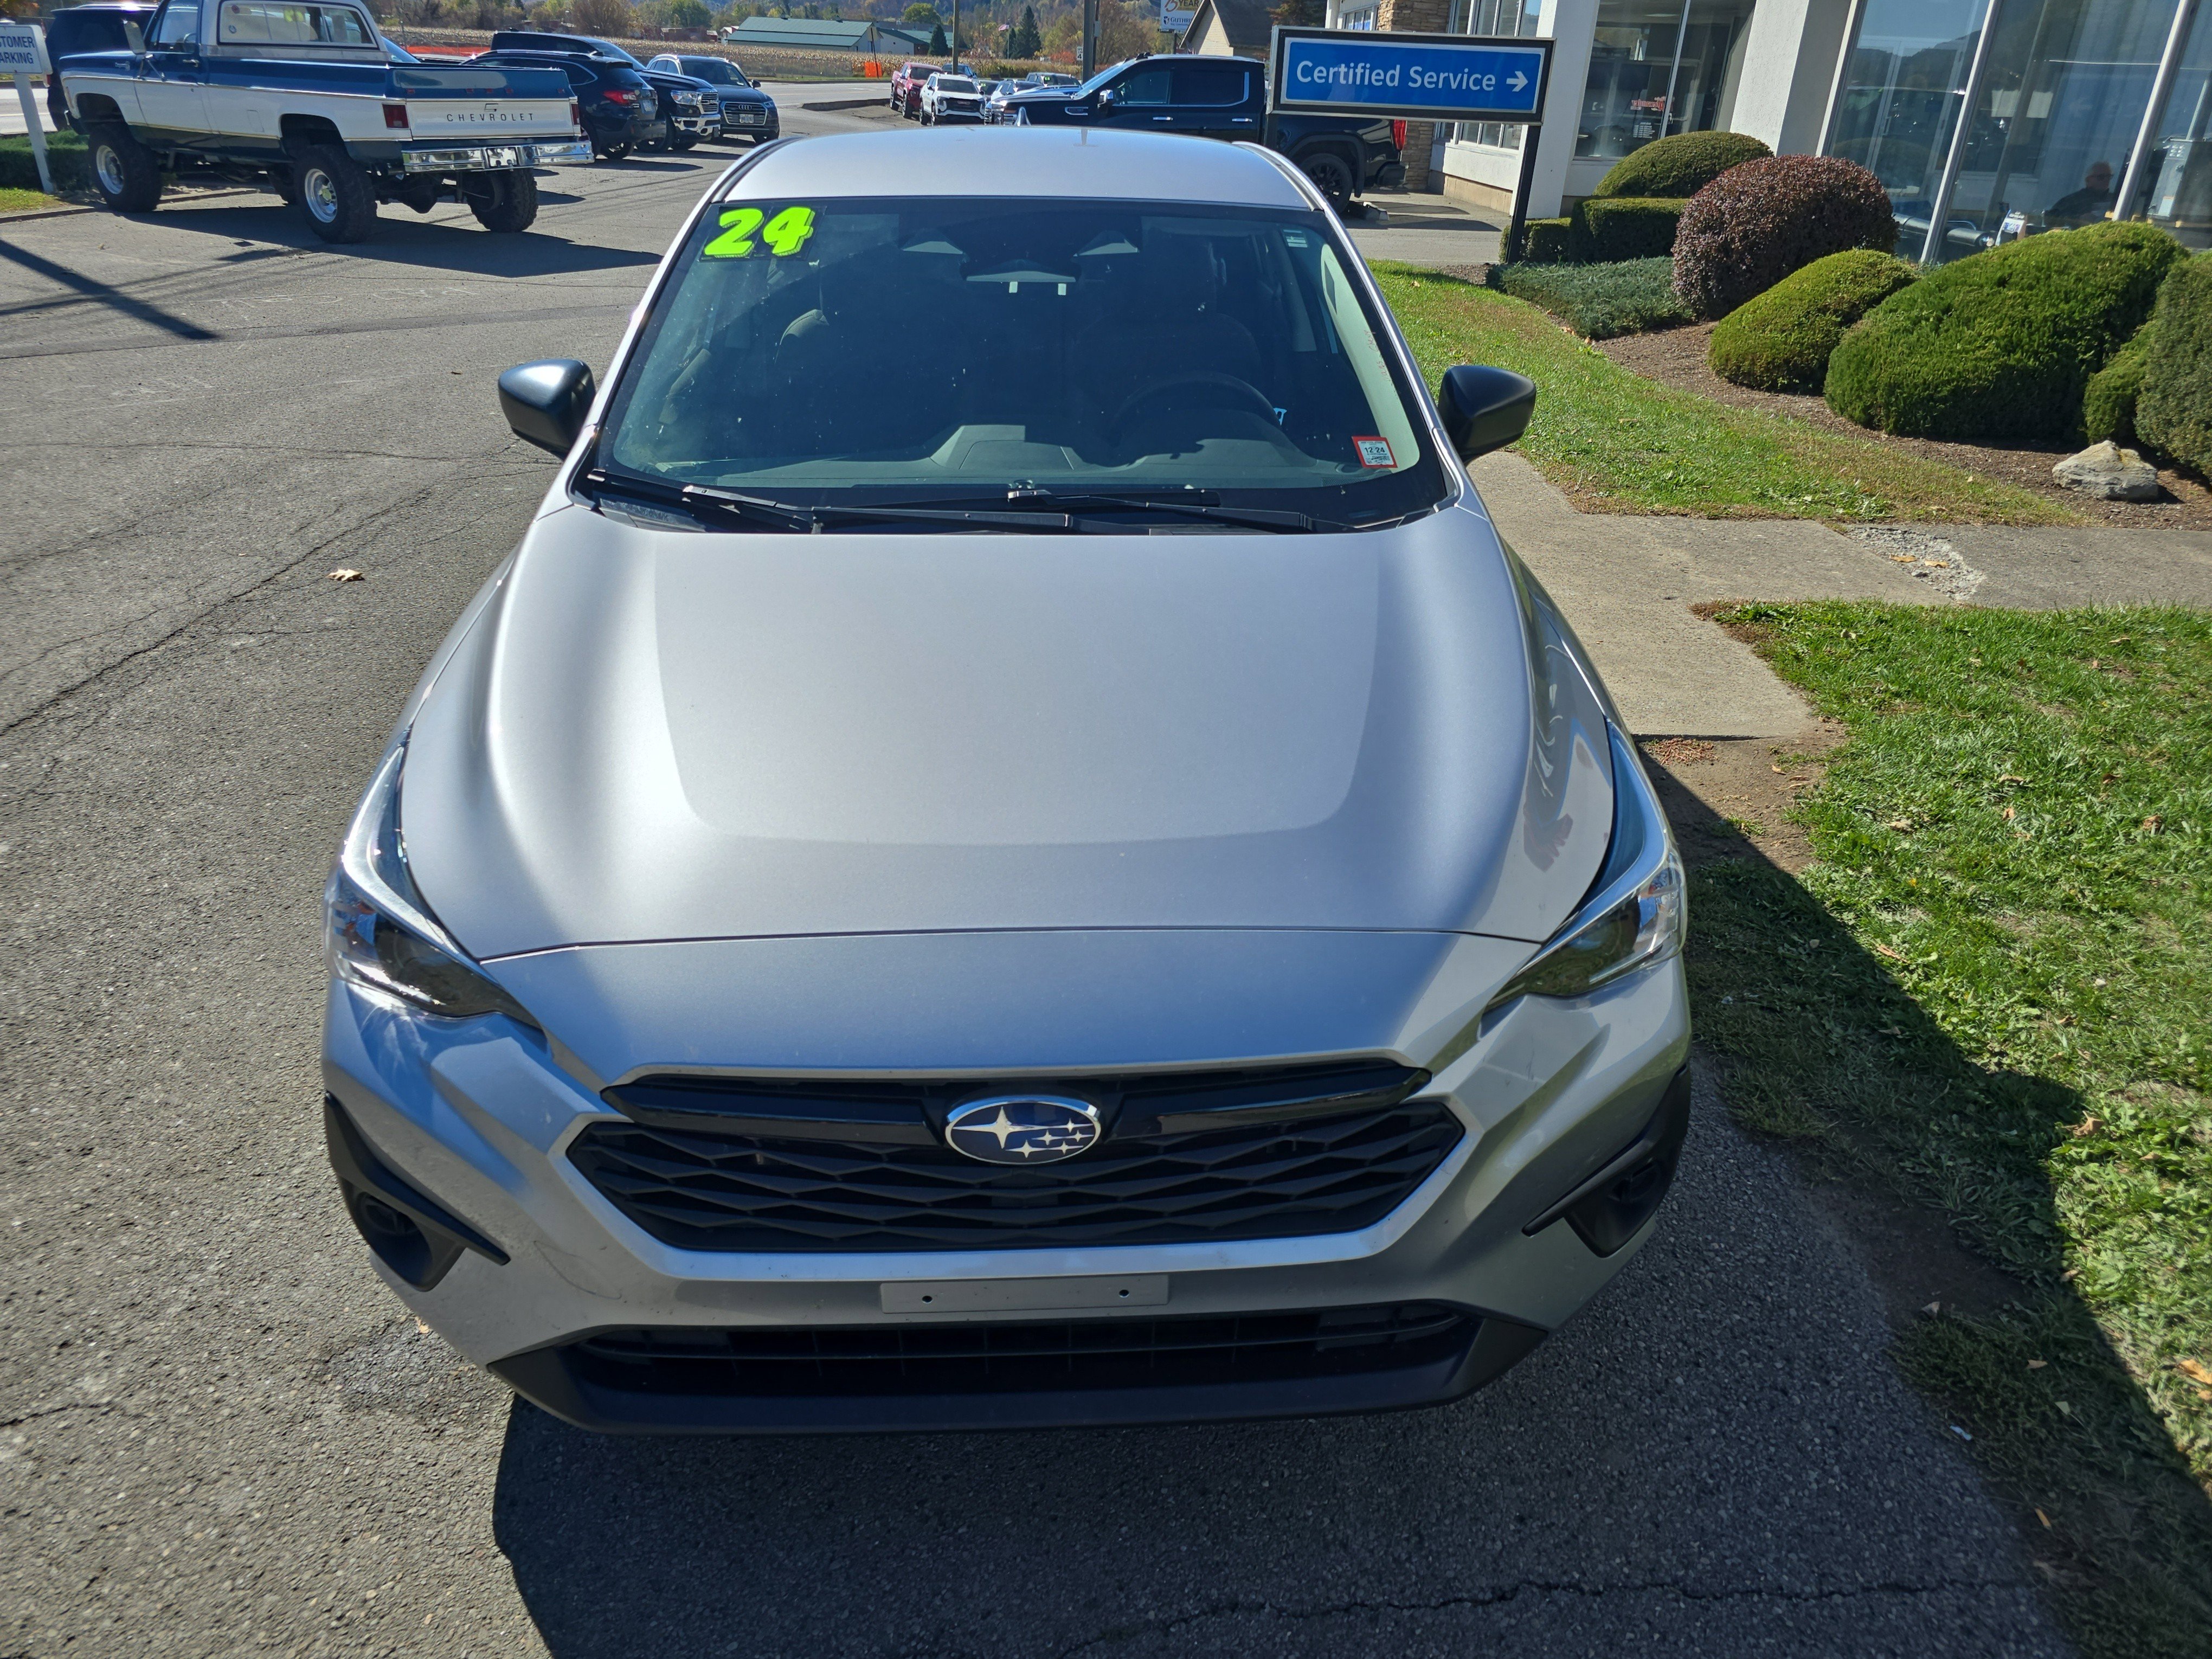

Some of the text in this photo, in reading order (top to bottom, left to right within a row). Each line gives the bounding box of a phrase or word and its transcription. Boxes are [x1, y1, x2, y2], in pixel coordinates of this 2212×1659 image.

[0, 36, 35, 48] TOMER
[1296, 61, 1496, 91] Certified Service
[447, 113, 533, 121] CHEVROLET
[704, 206, 815, 259] 24
